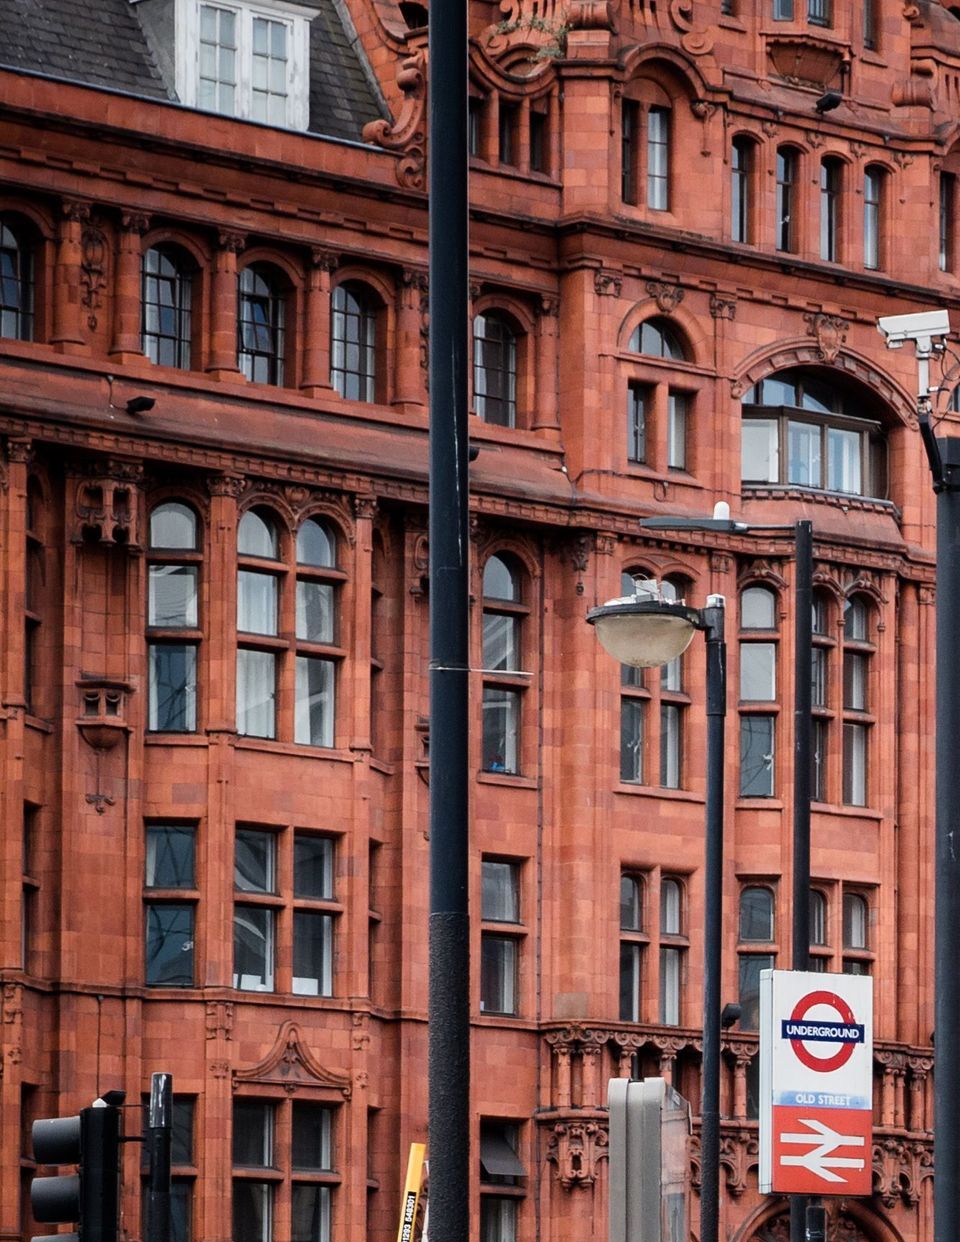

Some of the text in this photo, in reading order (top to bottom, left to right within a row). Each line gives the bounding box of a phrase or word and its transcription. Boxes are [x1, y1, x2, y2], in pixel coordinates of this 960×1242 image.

[786, 1025, 860, 1038] UNDERGROUND
[795, 1094, 851, 1106] OLD STREET
